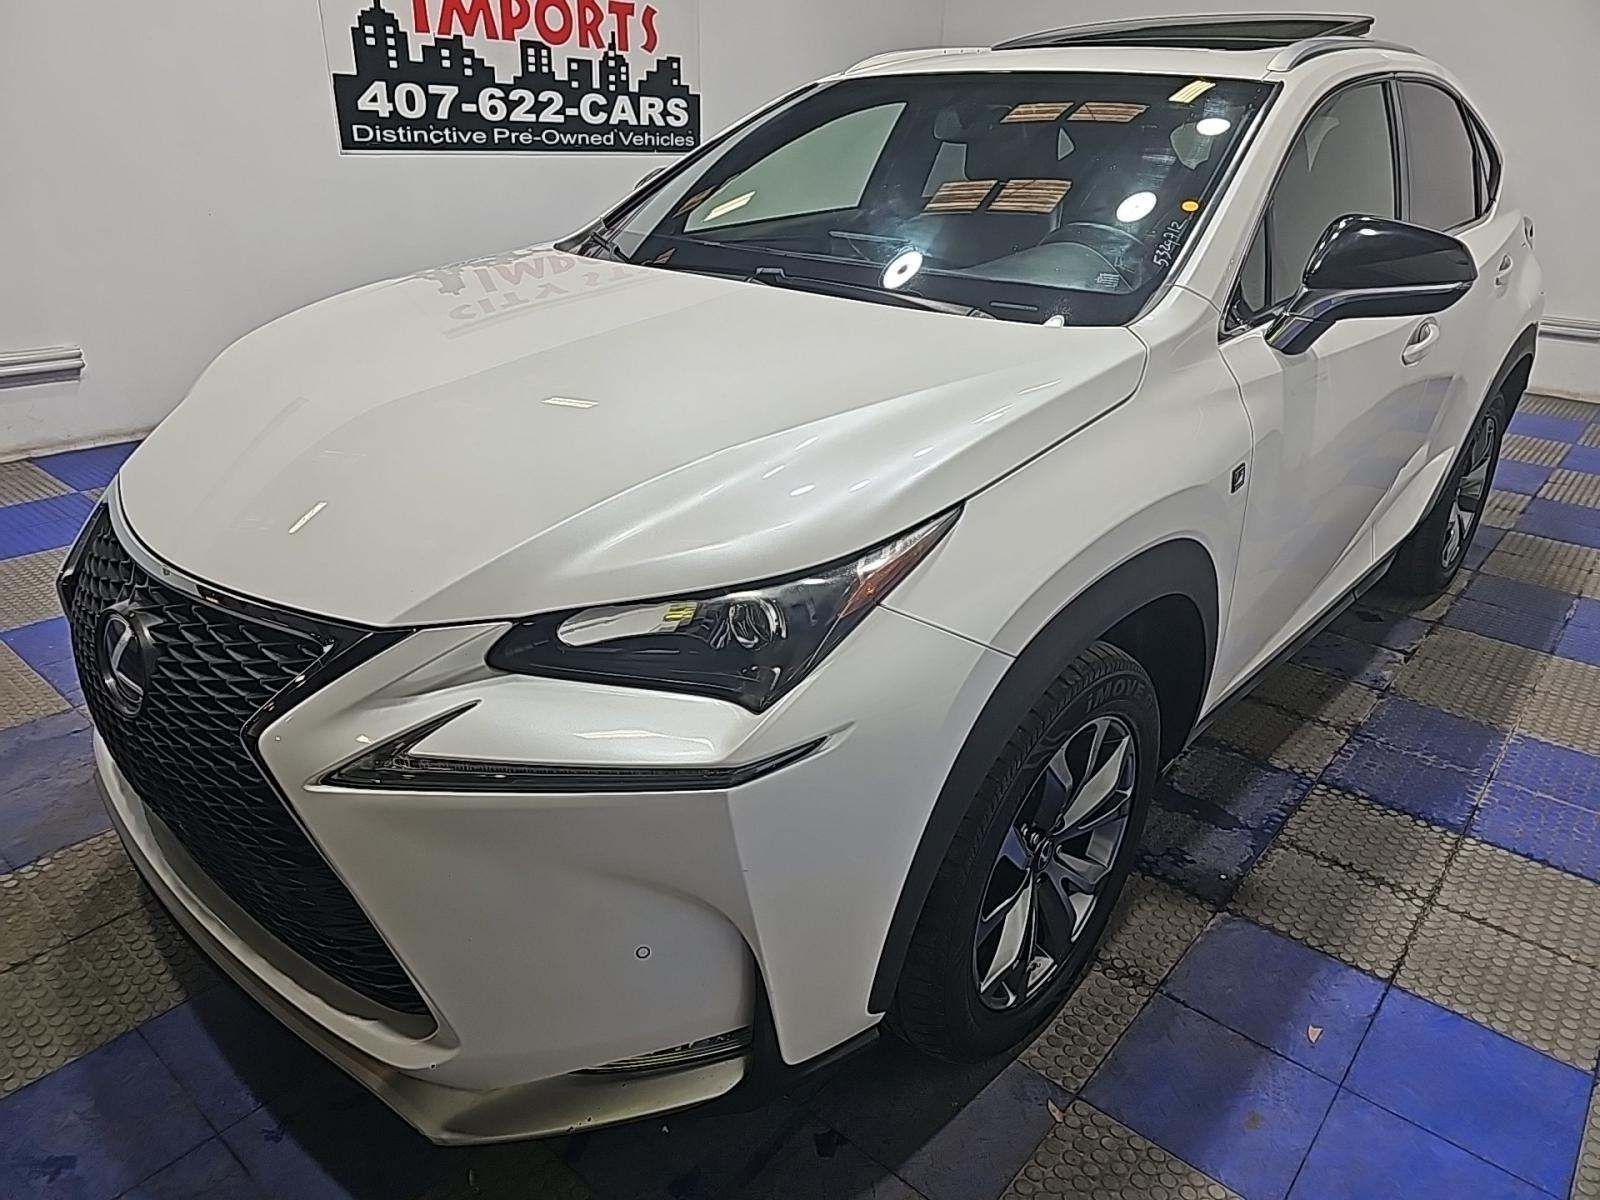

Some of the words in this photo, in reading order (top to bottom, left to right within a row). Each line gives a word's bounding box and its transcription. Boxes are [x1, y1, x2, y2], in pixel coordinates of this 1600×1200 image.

[413, 0, 657, 52] IMPORTS
[356, 81, 690, 126] 407-622-CARS
[352, 124, 487, 145] Distinctive
[493, 127, 615, 146] Pre-Owned
[618, 130, 695, 147] Vehicles
